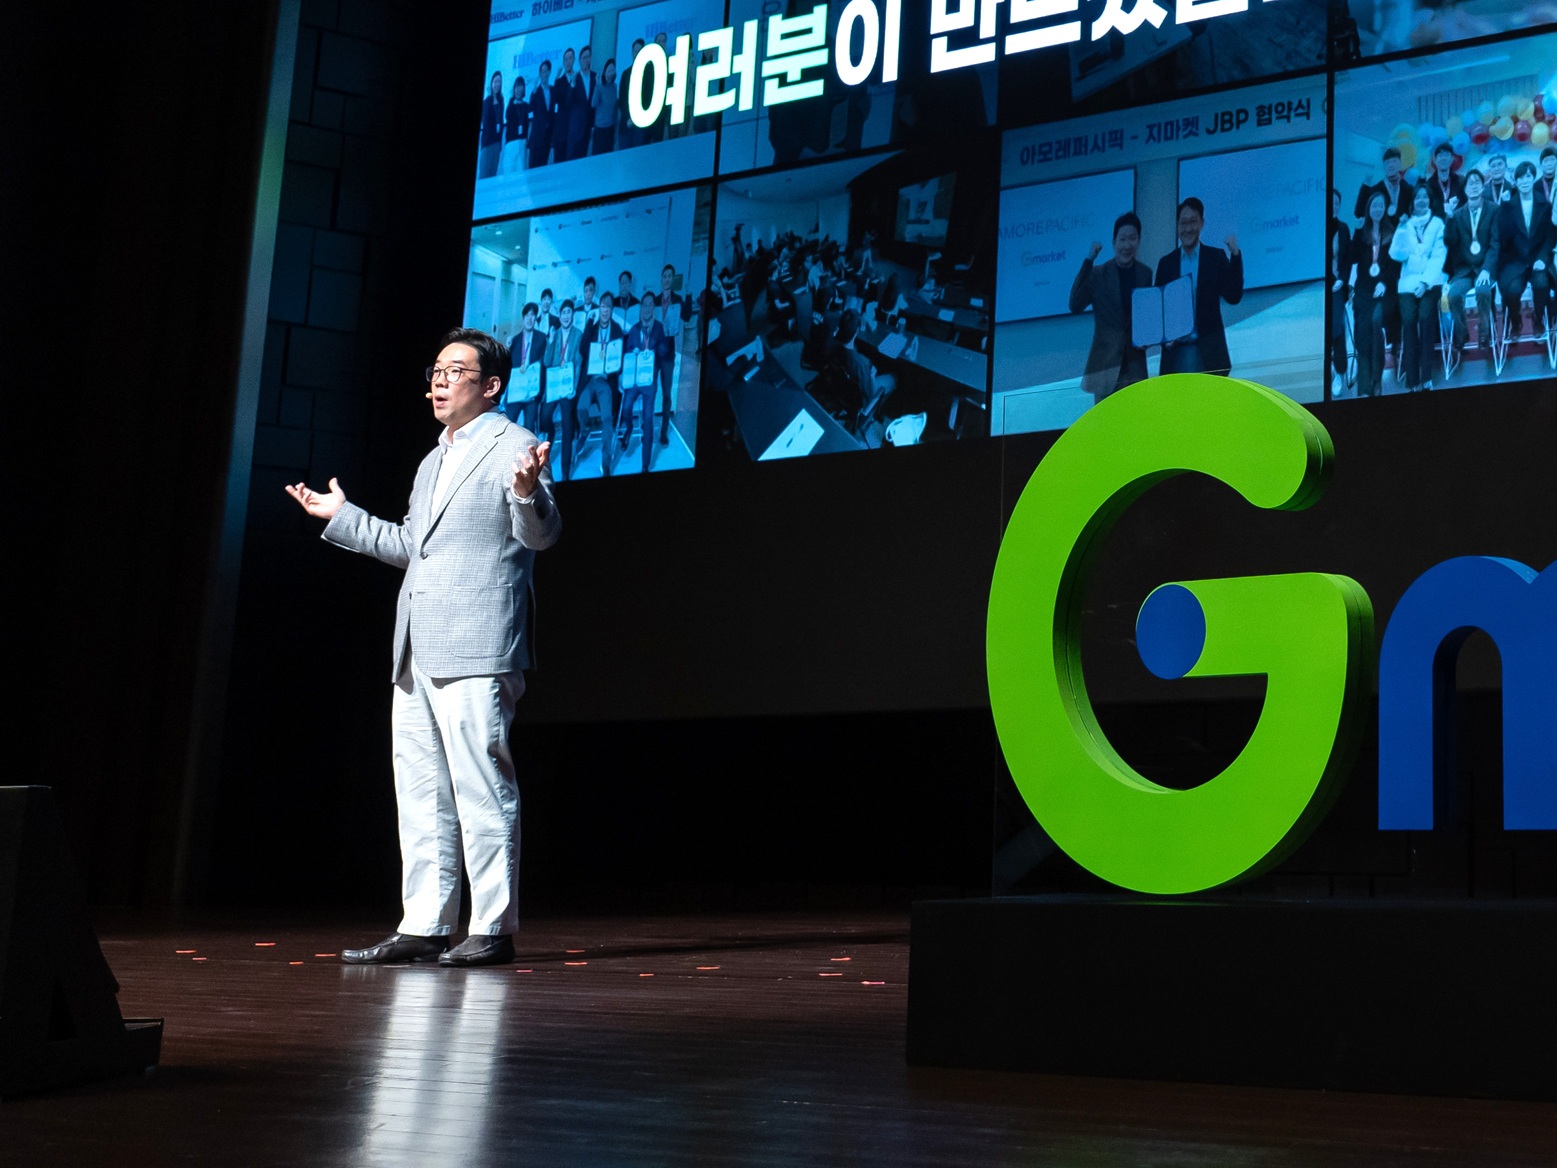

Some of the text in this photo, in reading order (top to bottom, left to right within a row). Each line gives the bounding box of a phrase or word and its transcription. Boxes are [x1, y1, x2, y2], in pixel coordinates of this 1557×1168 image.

[1019, 128, 1125, 166] 아모레퍼시픽
[1145, 116, 1200, 144] 지마켓
[1205, 108, 1250, 136] JBP
[1255, 97, 1312, 127] 협약식
